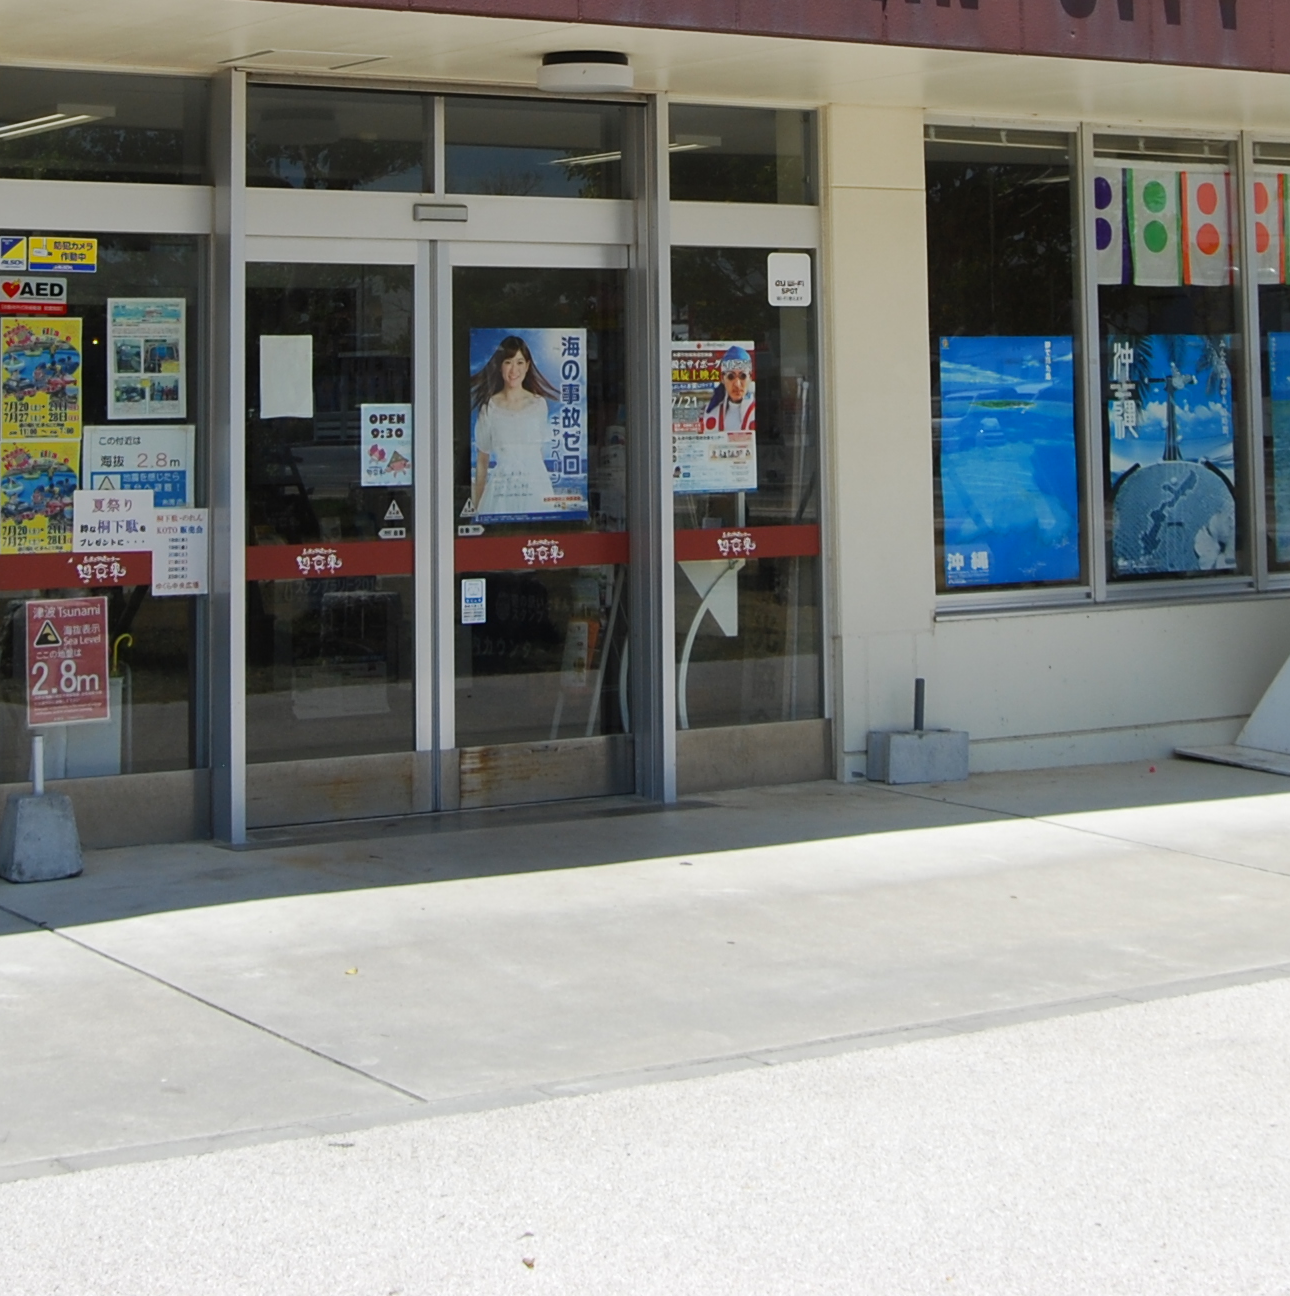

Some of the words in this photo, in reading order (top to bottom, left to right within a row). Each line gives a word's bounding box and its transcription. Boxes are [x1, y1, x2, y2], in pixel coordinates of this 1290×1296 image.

[53, 241, 94, 251] 防犯カメラ
[60, 252, 87, 262] 作動中
[20, 282, 64, 297] AED
[560, 335, 581, 476] 海の事故ゼロ
[369, 413, 406, 424] OPEN
[370, 428, 404, 439] 9:30
[98, 436, 141, 446] この付近は
[92, 498, 133, 513] 夏祭り
[33, 606, 56, 619] 津波
[57, 604, 101, 618] Tsunami
[63, 636, 78, 646] Sea
[80, 634, 101, 645] Level
